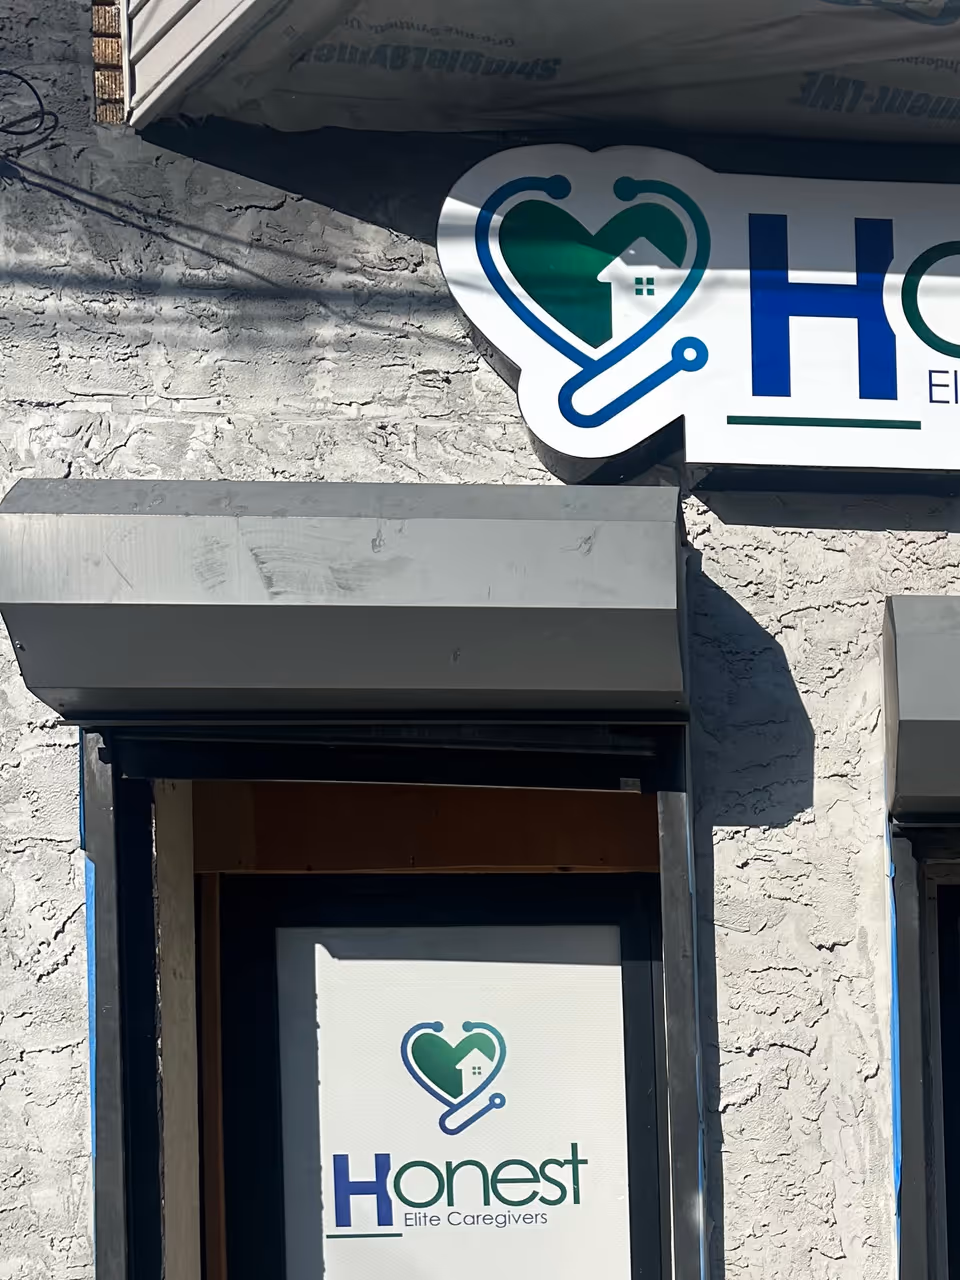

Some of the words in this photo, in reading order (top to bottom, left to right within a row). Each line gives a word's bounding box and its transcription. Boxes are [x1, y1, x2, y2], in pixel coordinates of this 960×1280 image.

[333, 1143, 588, 1227] Honest
[404, 1211, 441, 1227] Elite
[447, 1210, 548, 1229] Caregivers
